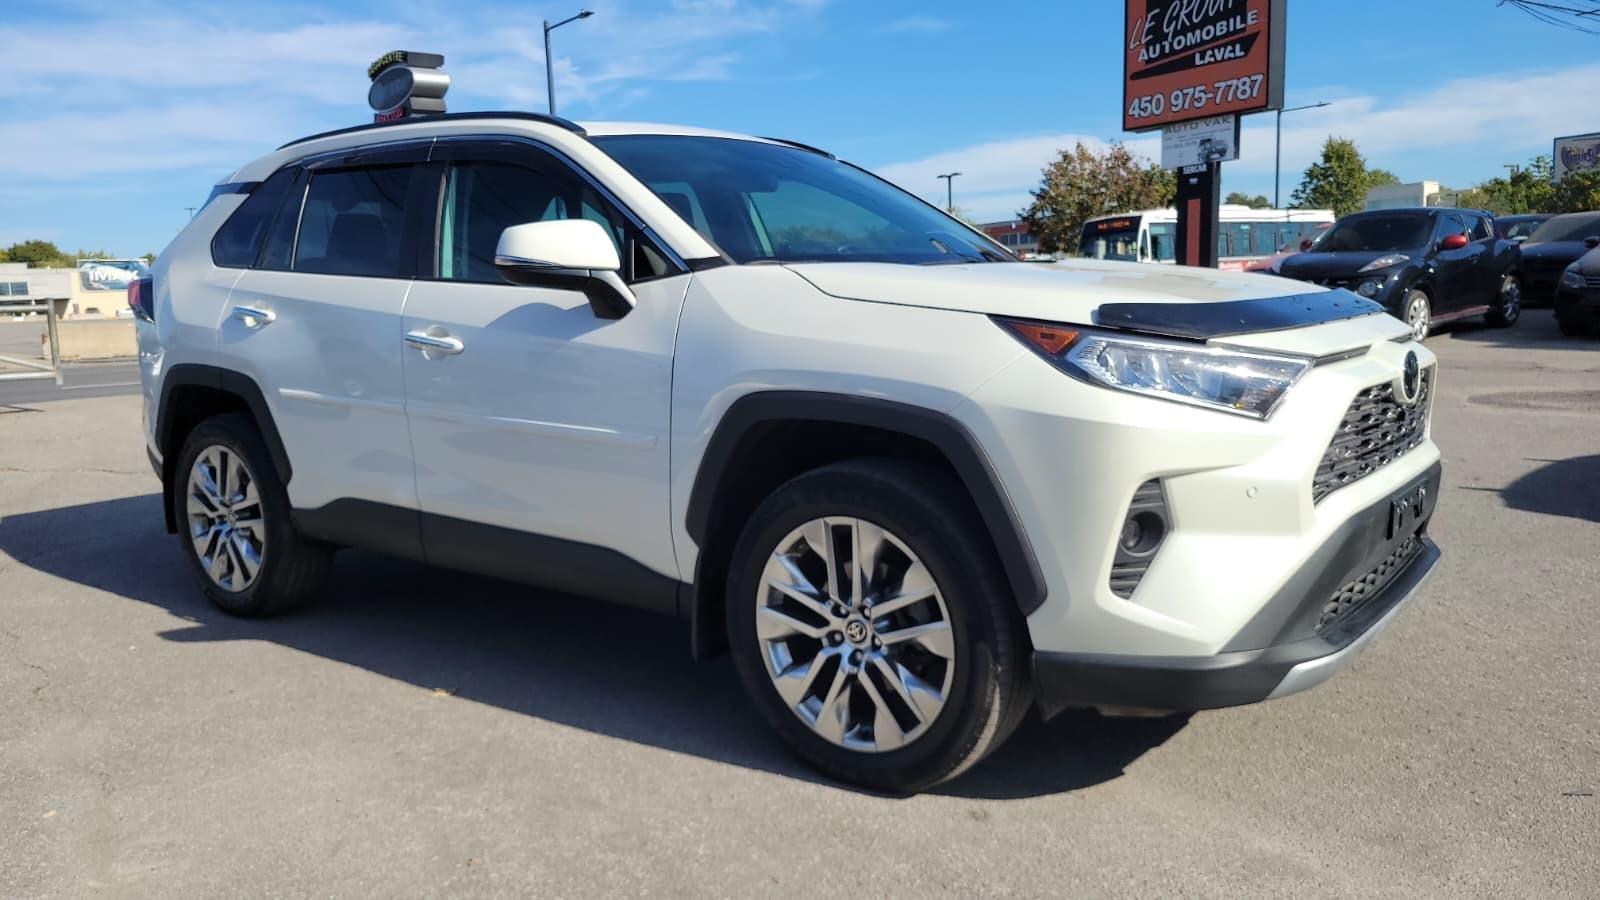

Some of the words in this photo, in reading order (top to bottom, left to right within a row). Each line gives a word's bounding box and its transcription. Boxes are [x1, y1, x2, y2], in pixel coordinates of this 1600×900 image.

[1129, 8, 1160, 49] LE
[1163, 0, 1233, 42] GROU
[1137, 9, 1259, 62] AUTOMOBILE
[1195, 43, 1245, 66] LAVAL
[1129, 94, 1164, 118] 450
[1171, 75, 1263, 111] 975-7787
[1164, 121, 1199, 135] AUTO
[1204, 117, 1232, 127] VAK
